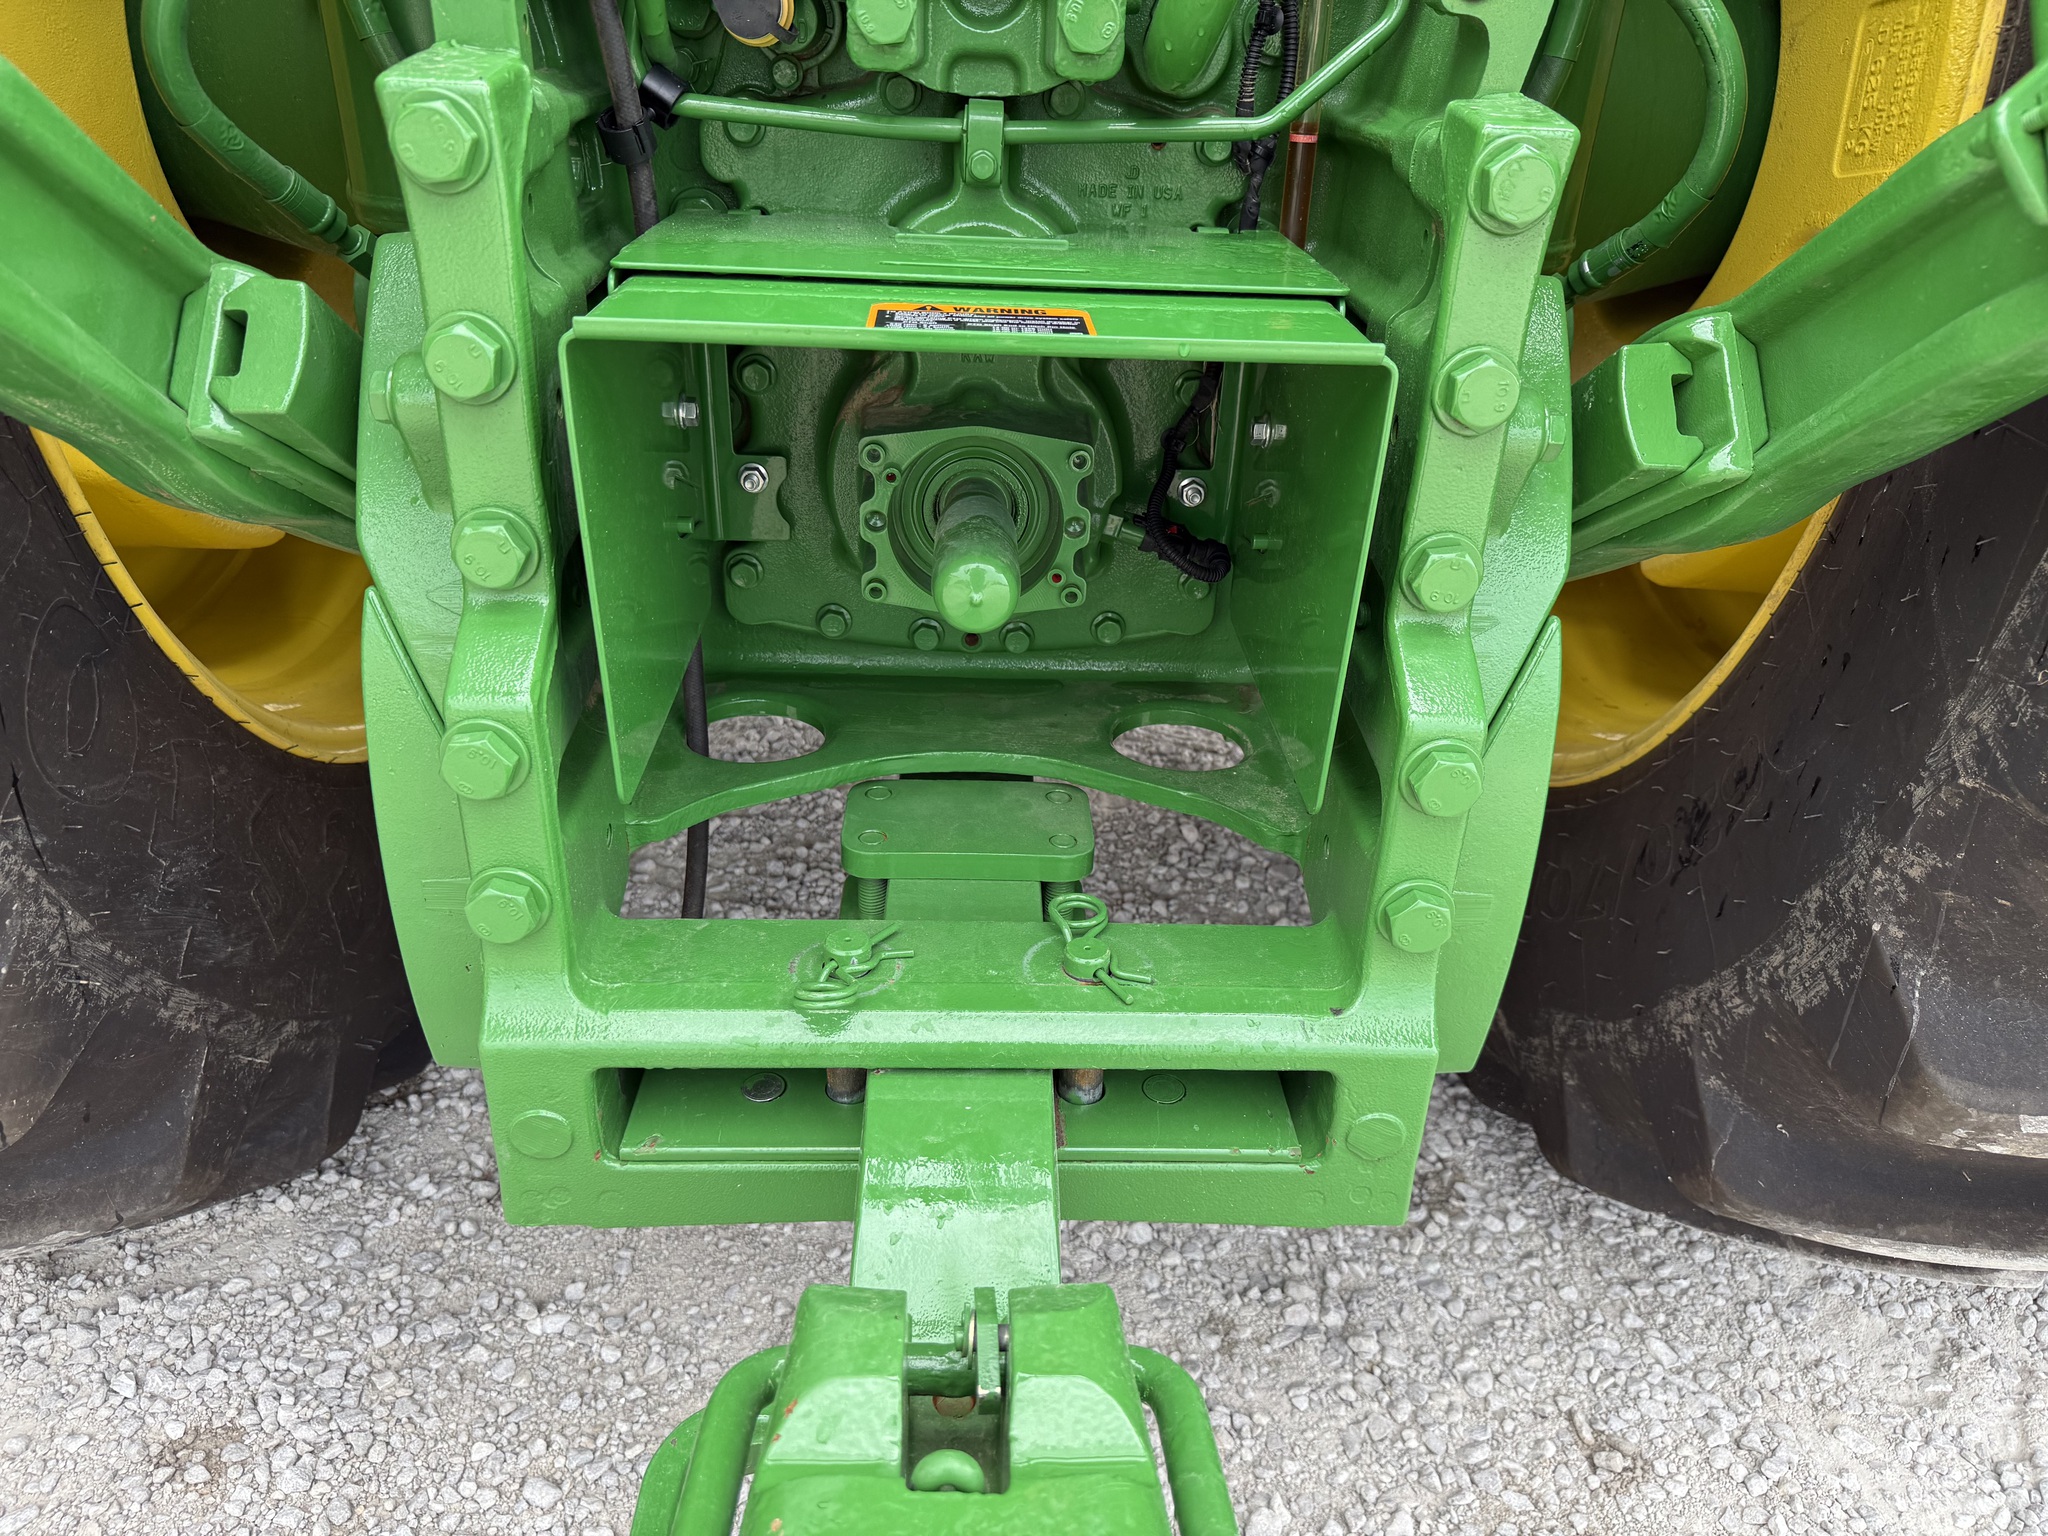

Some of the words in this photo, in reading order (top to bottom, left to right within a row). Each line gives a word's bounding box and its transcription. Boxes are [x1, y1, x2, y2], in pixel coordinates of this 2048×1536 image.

[1078, 183, 1117, 198] MADE
[1127, 184, 1144, 199] IN
[1153, 186, 1182, 200] USA
[953, 307, 1046, 315] WARNING
[467, 747, 497, 770] 10.9
[1450, 768, 1477, 790] 10.9
[497, 898, 524, 921] 10.9
